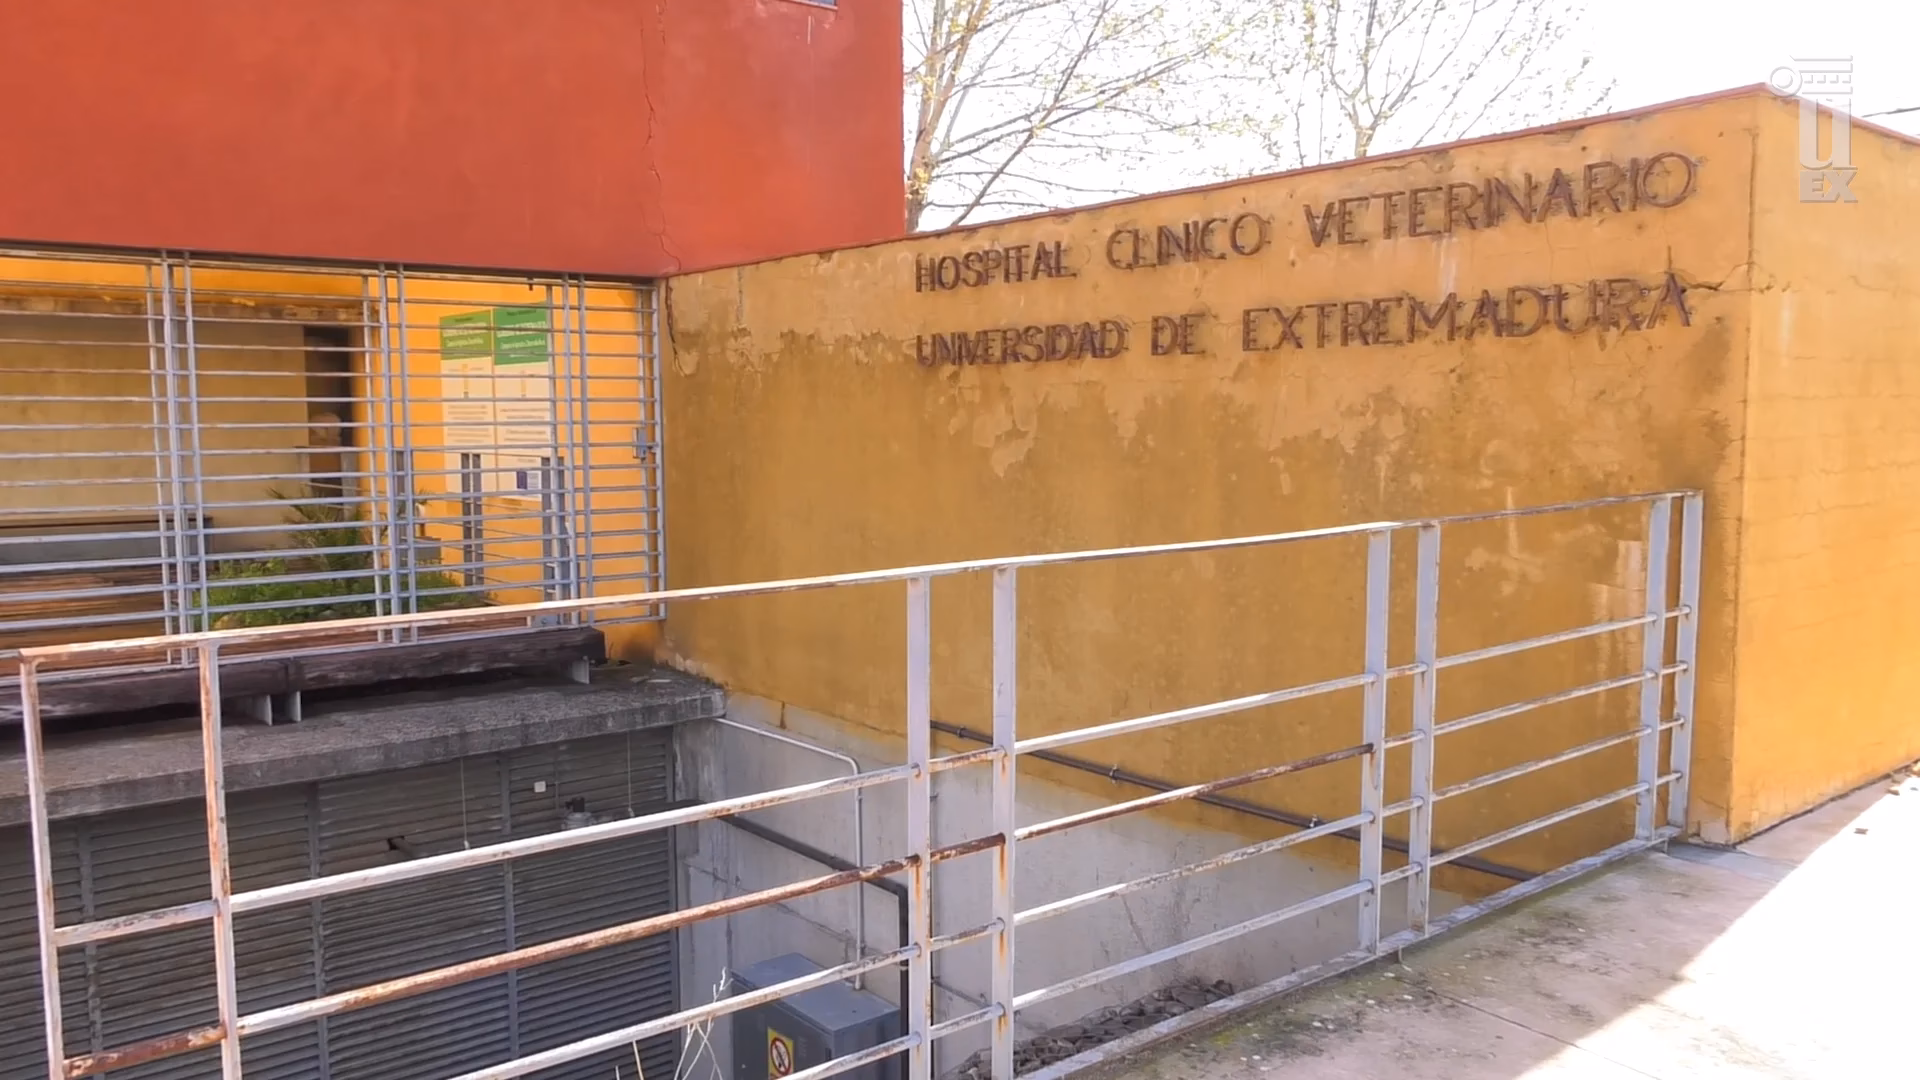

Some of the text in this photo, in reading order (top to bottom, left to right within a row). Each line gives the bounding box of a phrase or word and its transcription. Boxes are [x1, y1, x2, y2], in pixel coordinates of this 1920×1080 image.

[915, 151, 1696, 292] HOSPITAL CLINICO VETERINARIO
[916, 270, 1691, 368] UNIVERSIDAD DE EXTREMADURA
